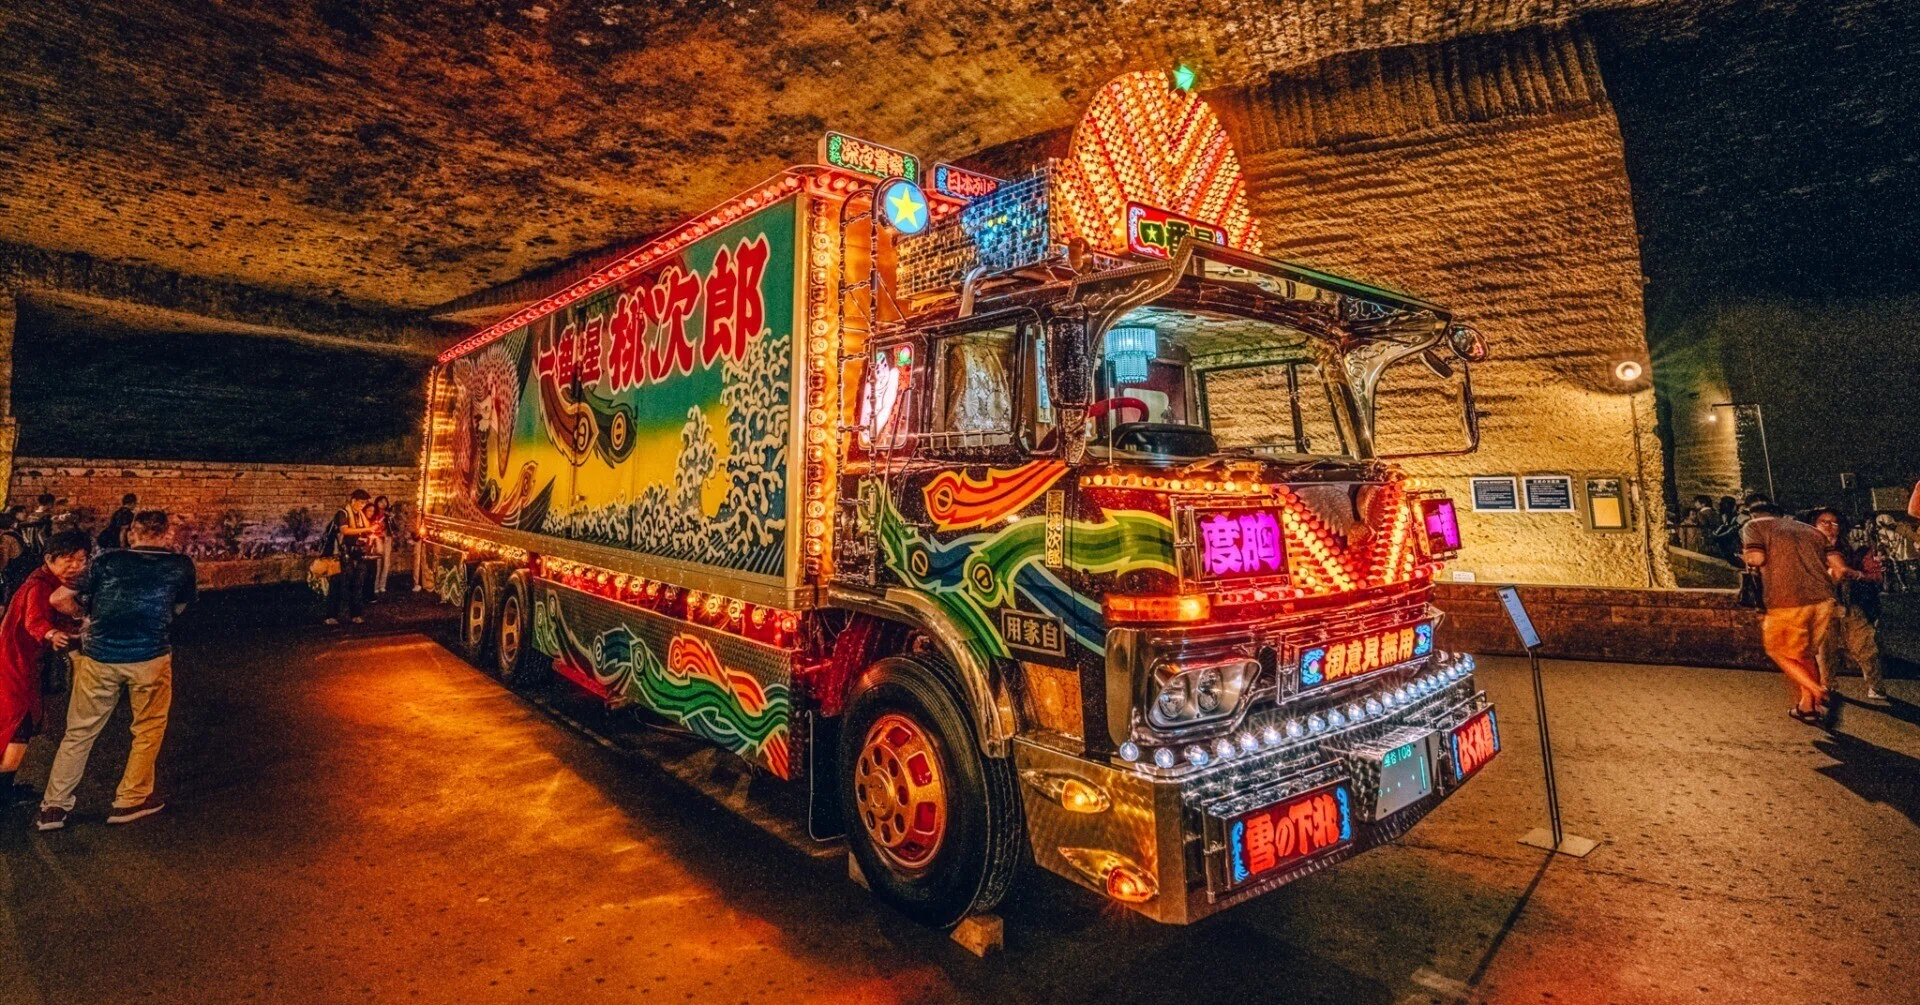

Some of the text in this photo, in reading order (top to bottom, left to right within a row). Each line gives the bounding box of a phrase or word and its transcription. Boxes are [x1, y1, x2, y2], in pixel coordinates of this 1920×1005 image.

[1201, 511, 1281, 574] 度胸
[1325, 627, 1415, 680] 御意見無用
